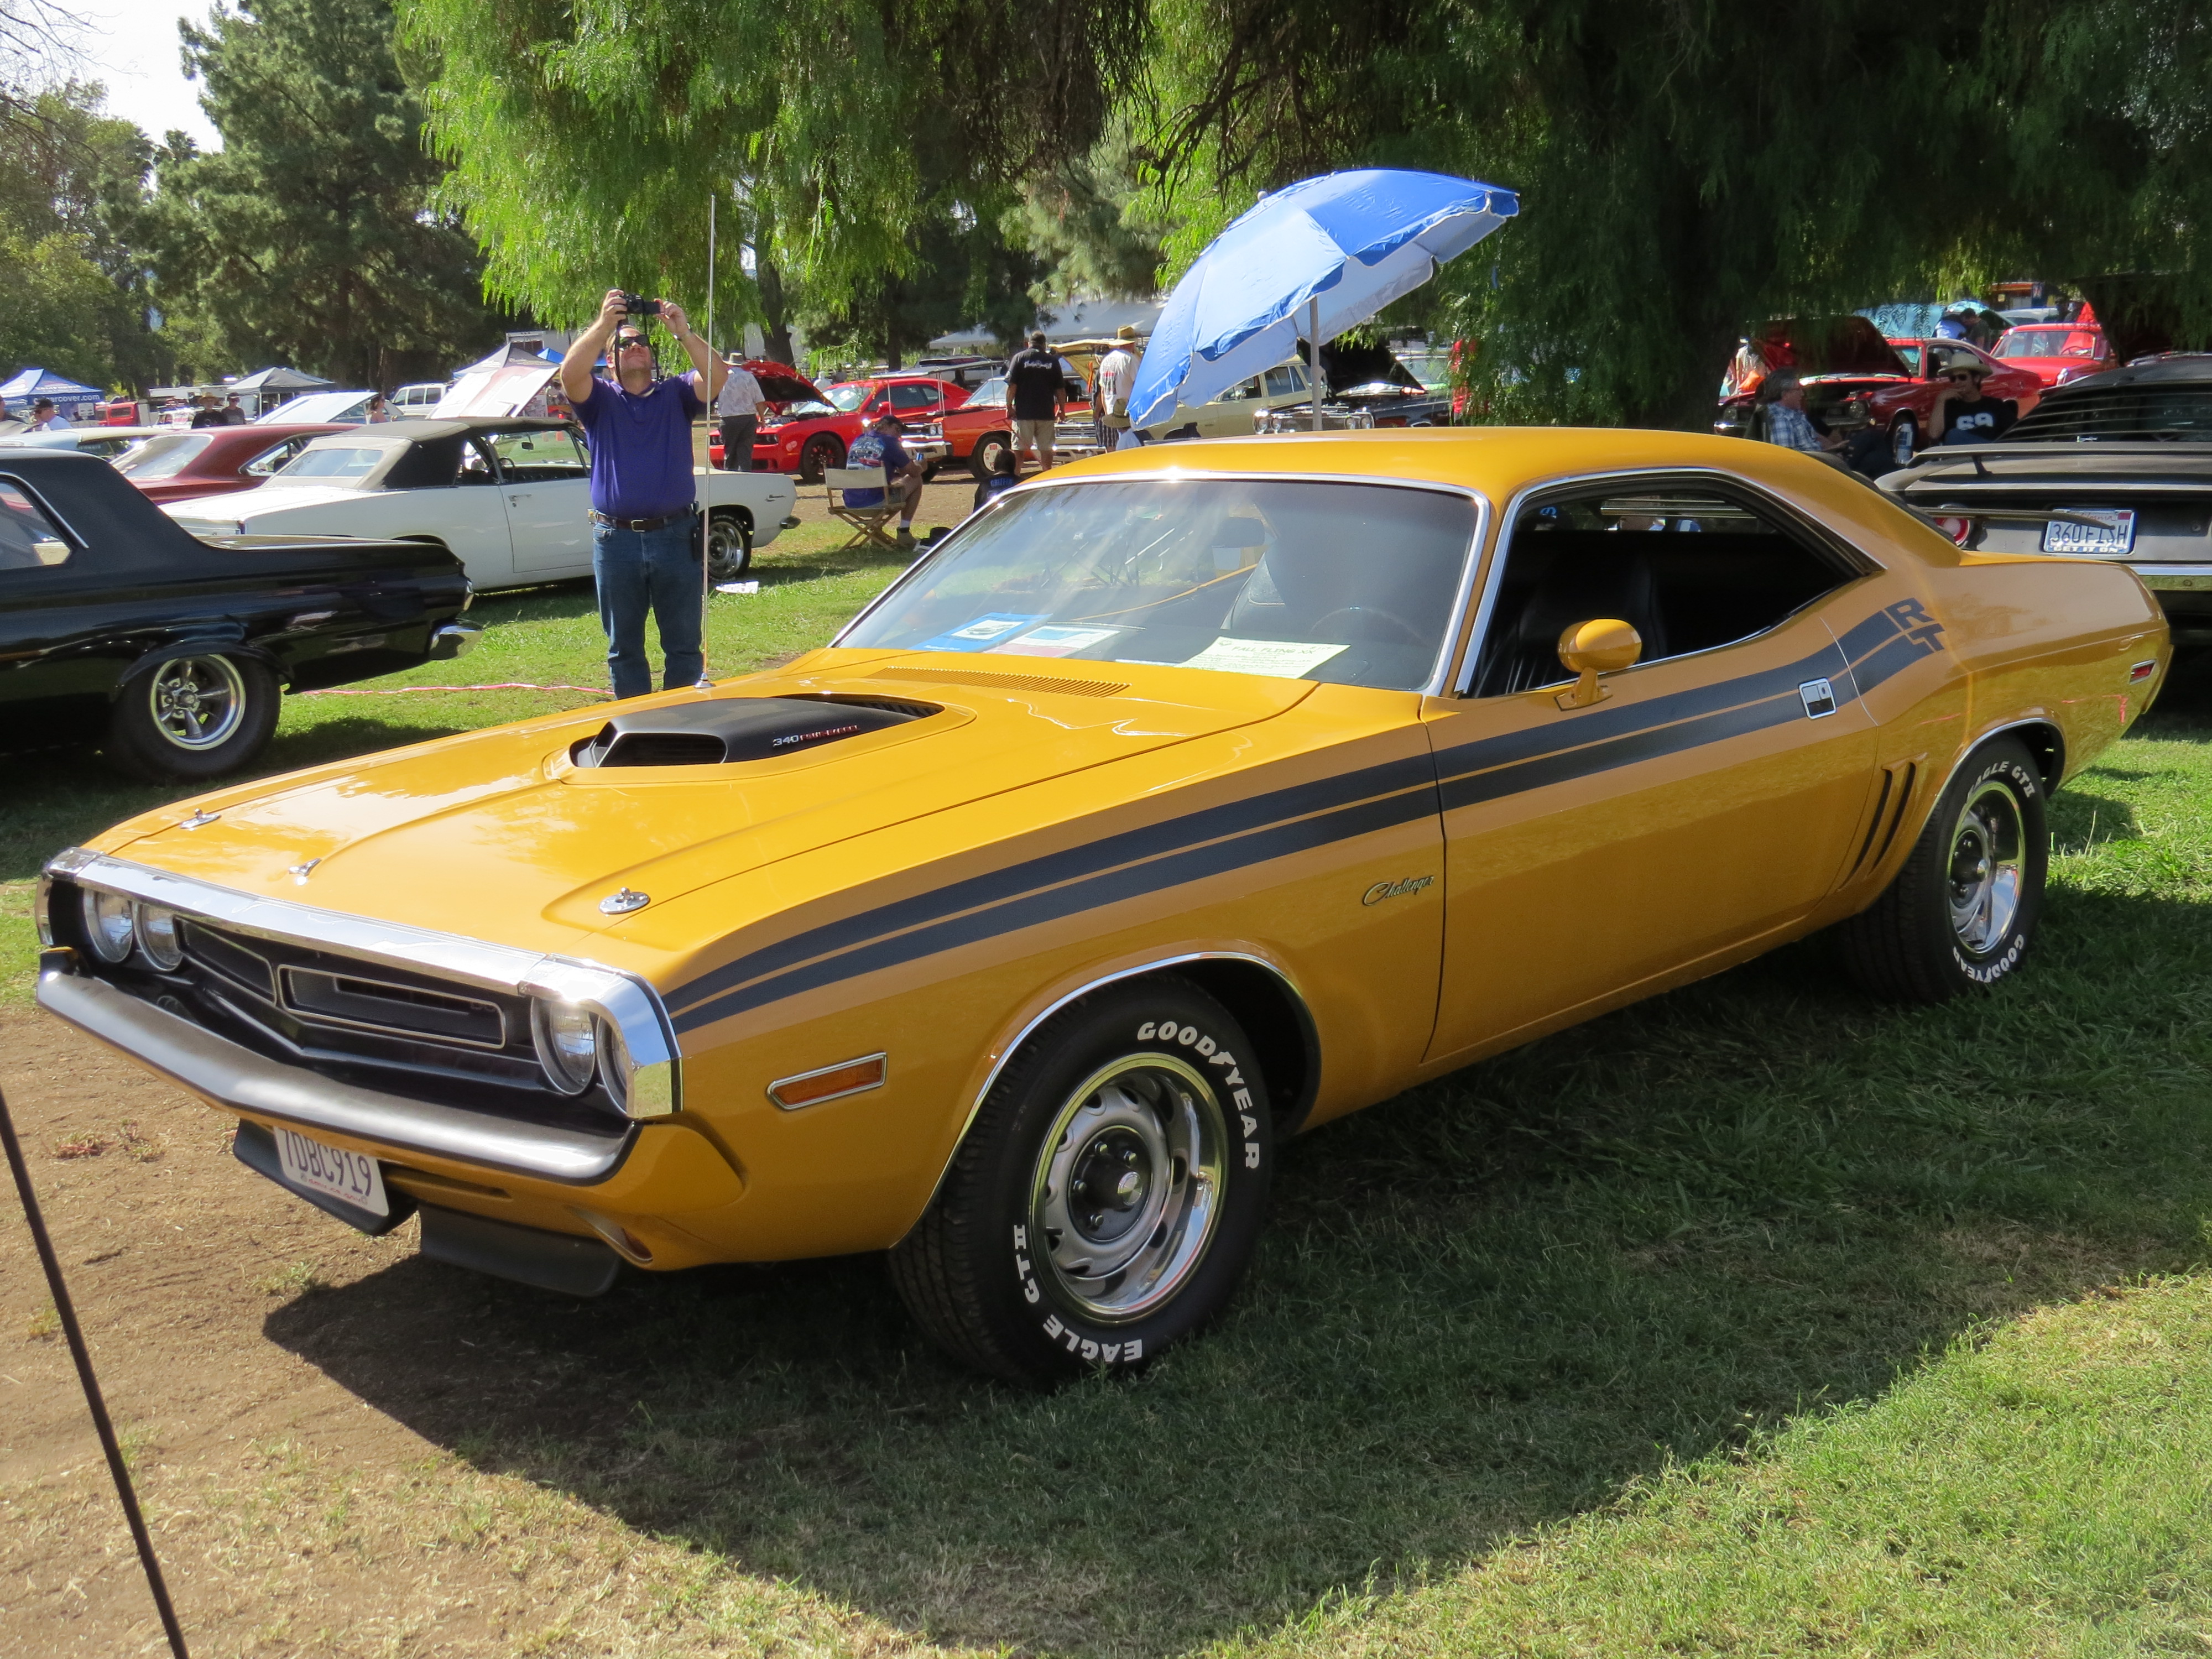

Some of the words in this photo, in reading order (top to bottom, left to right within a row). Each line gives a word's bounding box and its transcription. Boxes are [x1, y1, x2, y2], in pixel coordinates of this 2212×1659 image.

[1956, 413, 1994, 430] 69
[773, 734, 799, 747] 340
[1362, 875, 1434, 906] Challenger
[1953, 934, 2025, 983] GOODYEAR
[1137, 1020, 1260, 1169] GOODYEAR
[1043, 1314, 1144, 1362] EAGLE
